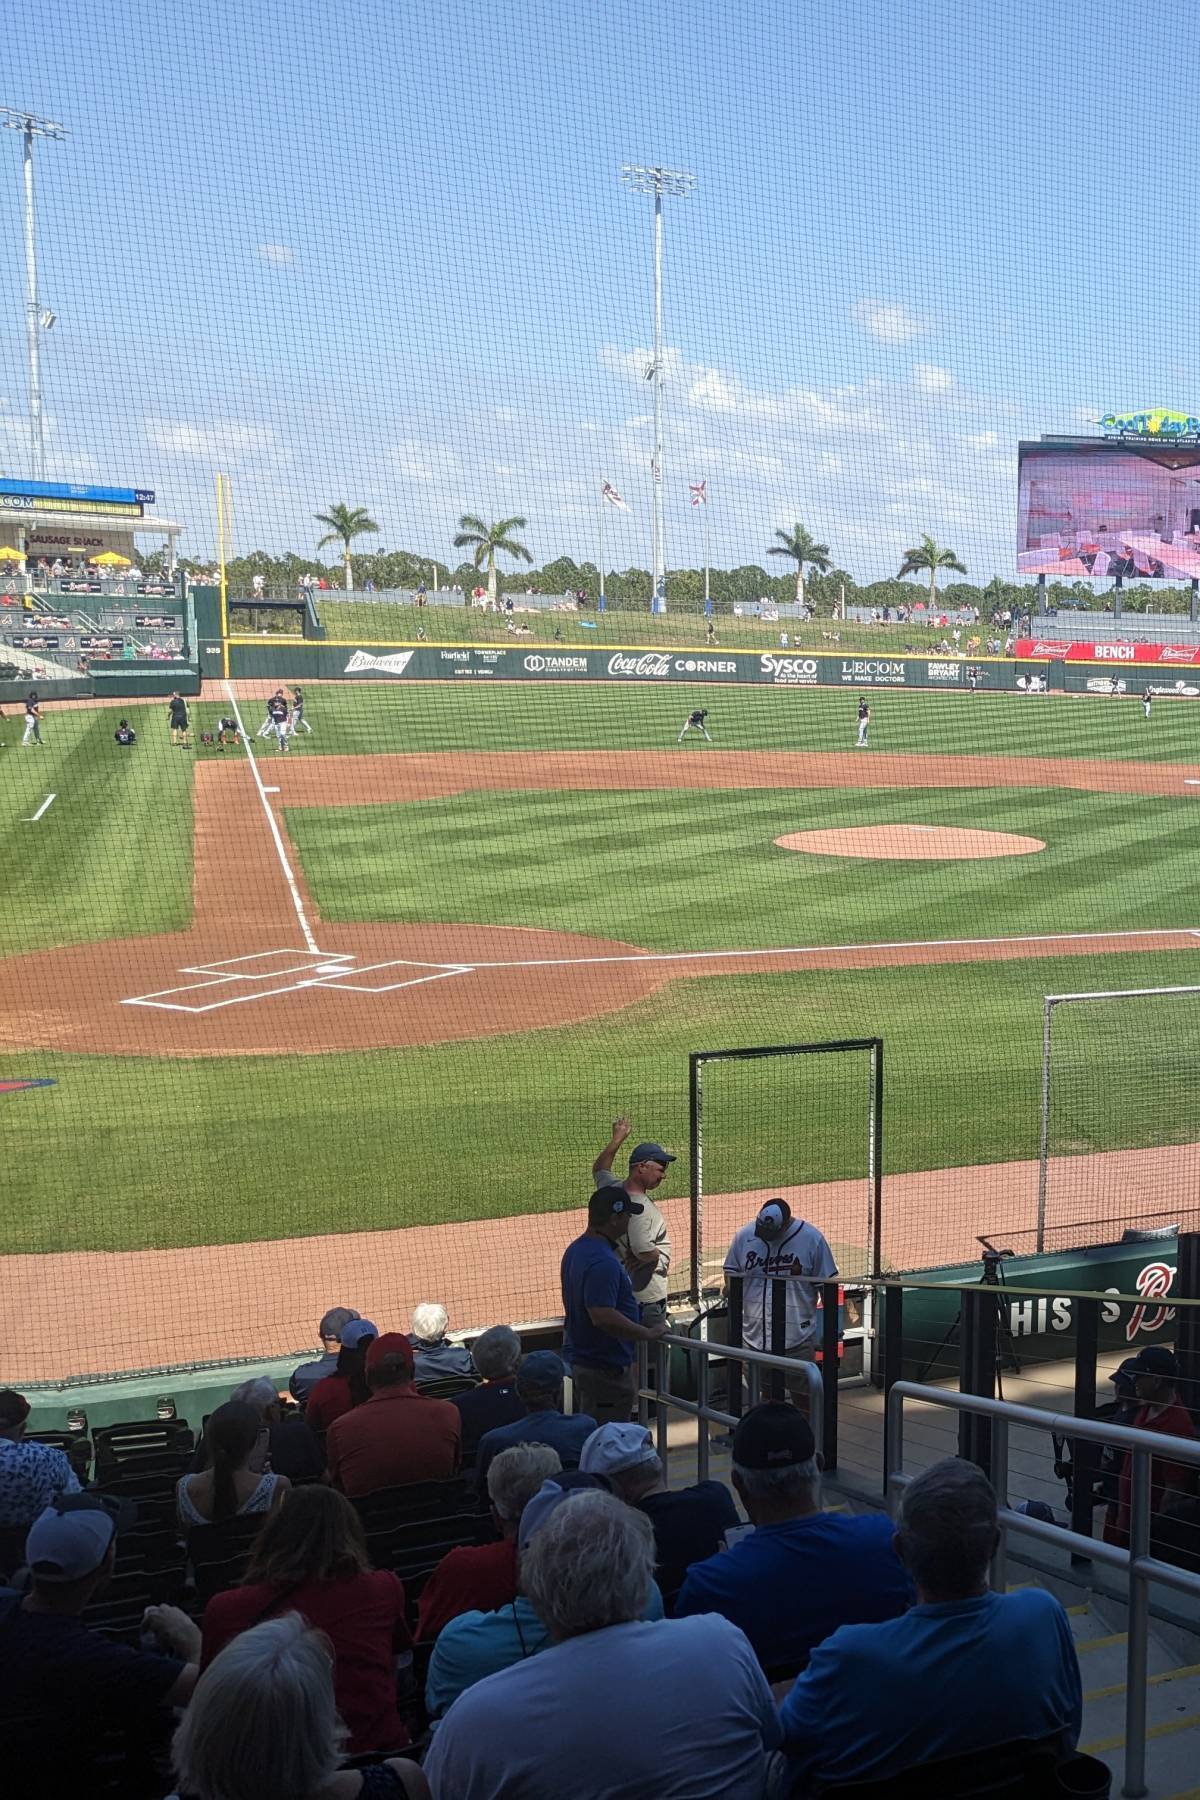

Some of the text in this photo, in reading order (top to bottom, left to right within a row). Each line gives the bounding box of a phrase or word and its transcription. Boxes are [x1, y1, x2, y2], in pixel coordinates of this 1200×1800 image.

[30, 534, 104, 547] SAUSAGE SHACK
[1095, 645, 1135, 659] BENCH
[350, 655, 407, 669] Budweiser
[545, 657, 588, 667] TANDEM
[607, 652, 673, 676] Coca-Cola
[675, 660, 737, 673] CORNER
[761, 654, 817, 676] Sysco
[928, 662, 960, 670] FAWLEY
[1008, 1297, 1072, 1338] HIS
